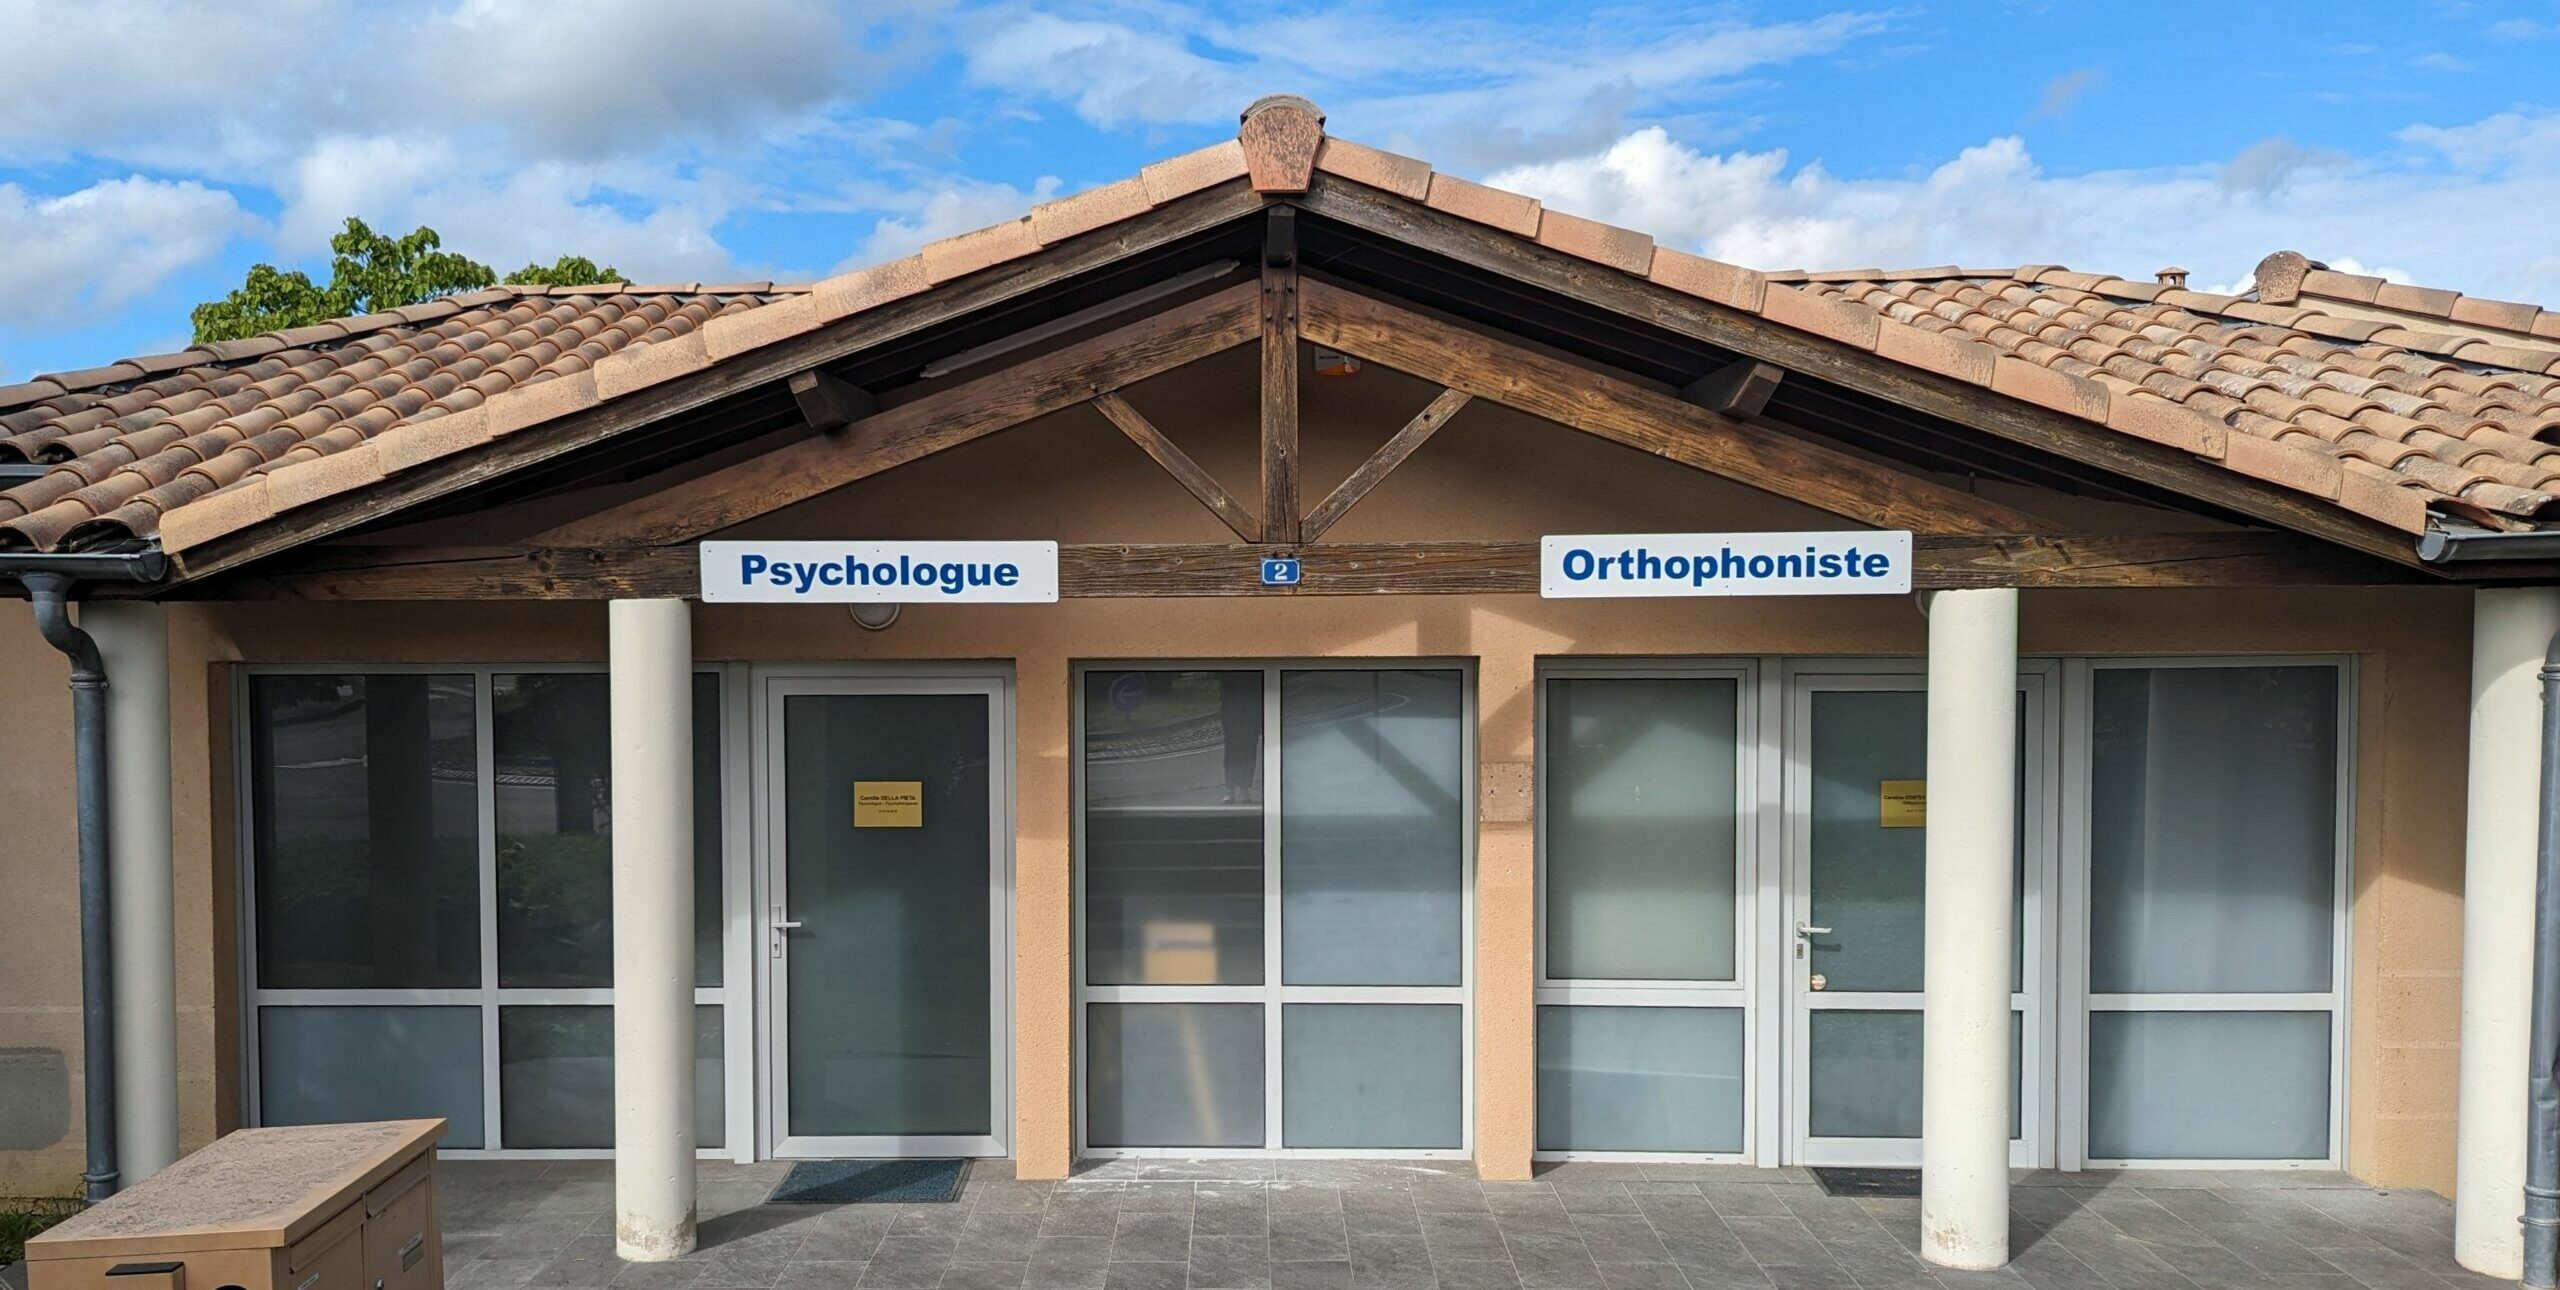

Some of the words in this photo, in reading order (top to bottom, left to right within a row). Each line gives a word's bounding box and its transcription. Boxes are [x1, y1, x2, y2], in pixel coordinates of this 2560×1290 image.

[741, 555, 1019, 594] Psychologue
[1274, 563, 1288, 581] 2
[1562, 547, 1890, 587] Orthophoniste
